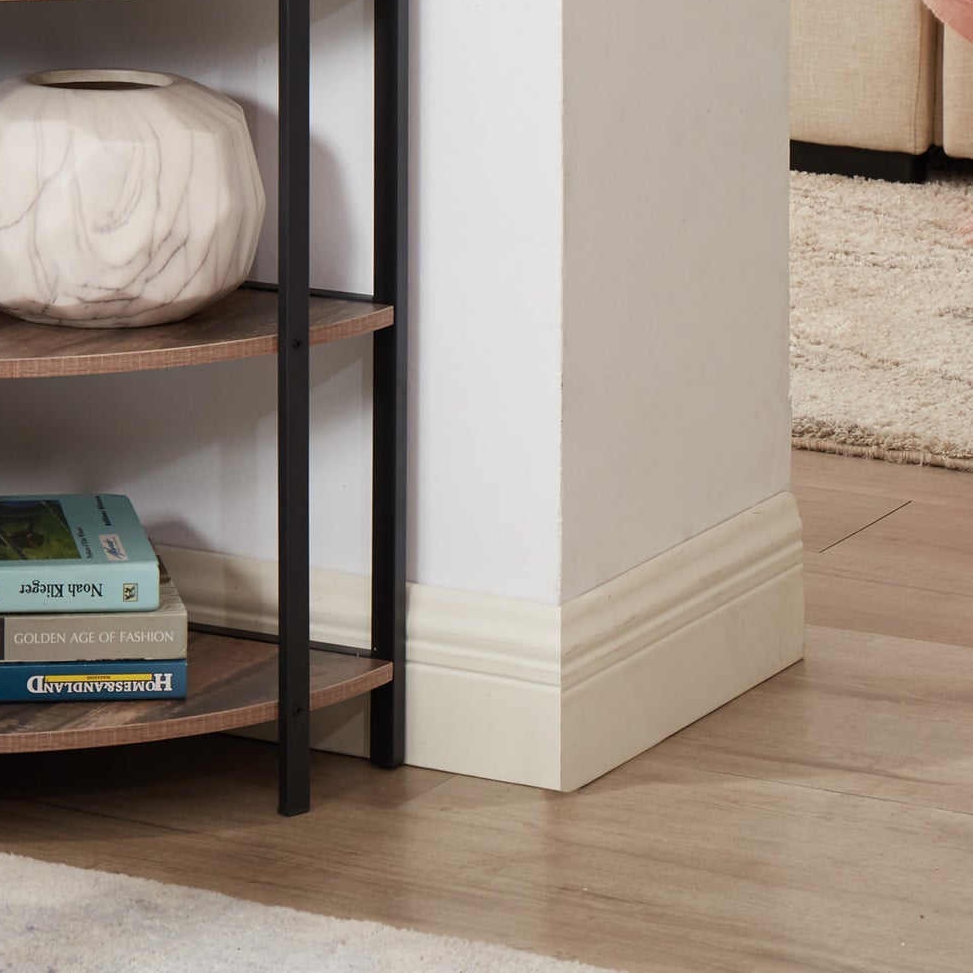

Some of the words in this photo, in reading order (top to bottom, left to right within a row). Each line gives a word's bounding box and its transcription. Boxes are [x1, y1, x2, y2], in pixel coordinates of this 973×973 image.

[19, 580, 64, 599] Klieger
[68, 583, 104, 598] Noah
[14, 632, 66, 644] GOLDEN
[70, 632, 96, 644] AGE
[98, 631, 116, 644] OF
[120, 631, 174, 643] FASHION
